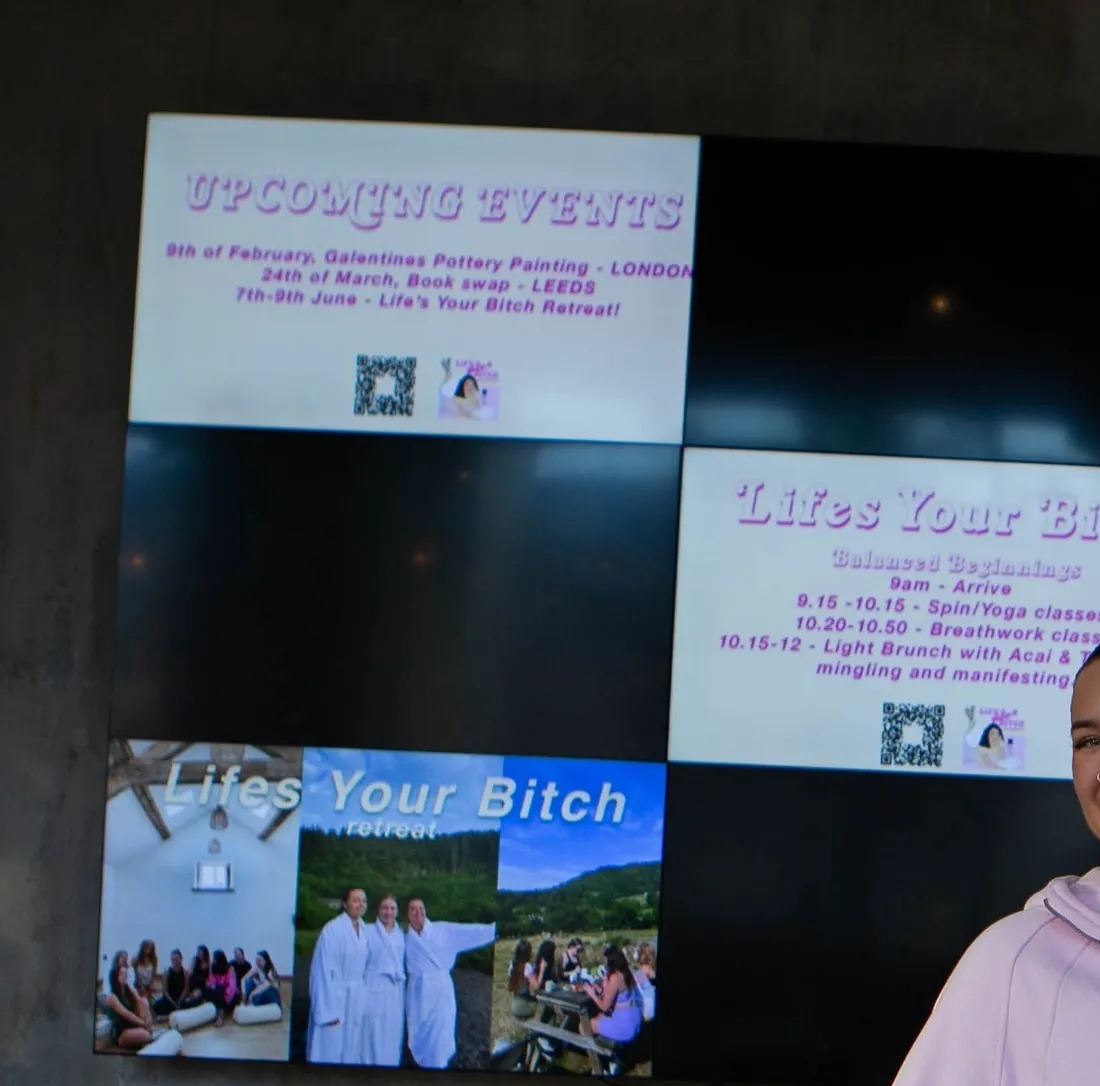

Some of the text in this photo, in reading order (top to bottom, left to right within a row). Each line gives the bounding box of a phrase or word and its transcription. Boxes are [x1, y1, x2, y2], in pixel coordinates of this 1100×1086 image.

[186, 173, 684, 231] UPCOMING EVENTS
[166, 243, 196, 258] 9th
[203, 245, 223, 258] of
[229, 245, 315, 265] February,
[325, 249, 425, 267] Galentines
[433, 253, 503, 272] Pottery
[510, 256, 588, 276] Painting
[610, 261, 695, 279] LONDON
[261, 267, 302, 283] 24th
[310, 270, 330, 284] of
[335, 270, 399, 289] March,
[407, 273, 454, 290] Book
[462, 278, 510, 293] swap
[532, 278, 596, 294] LEEDS
[236, 287, 304, 304] 7th-9th
[311, 290, 357, 306] June
[379, 293, 429, 309] Life's
[438, 295, 479, 311] Your
[485, 297, 535, 314] Bitch
[542, 300, 621, 317] Retreat!
[736, 481, 881, 529] Lifes
[898, 488, 1021, 536] Your
[832, 548, 1082, 582] Balanced Beginnings
[889, 576, 930, 592] 9am
[953, 579, 1012, 595] Arrive
[797, 593, 838, 610] 9.15
[928, 600, 1027, 622] Spin/Yoga
[797, 616, 907, 635] 10.20-10.50
[930, 621, 1045, 641] Breathwork
[720, 634, 802, 652] 10.15-12
[824, 638, 874, 658] Light
[881, 641, 951, 659] Brunch
[960, 645, 1001, 661] with
[1009, 647, 1052, 664] Acai
[1059, 650, 1071, 664] &
[816, 661, 902, 682] mingling
[909, 666, 946, 681] and
[164, 762, 627, 823] Lifes Your Bitch
[347, 820, 437, 840] retreat
